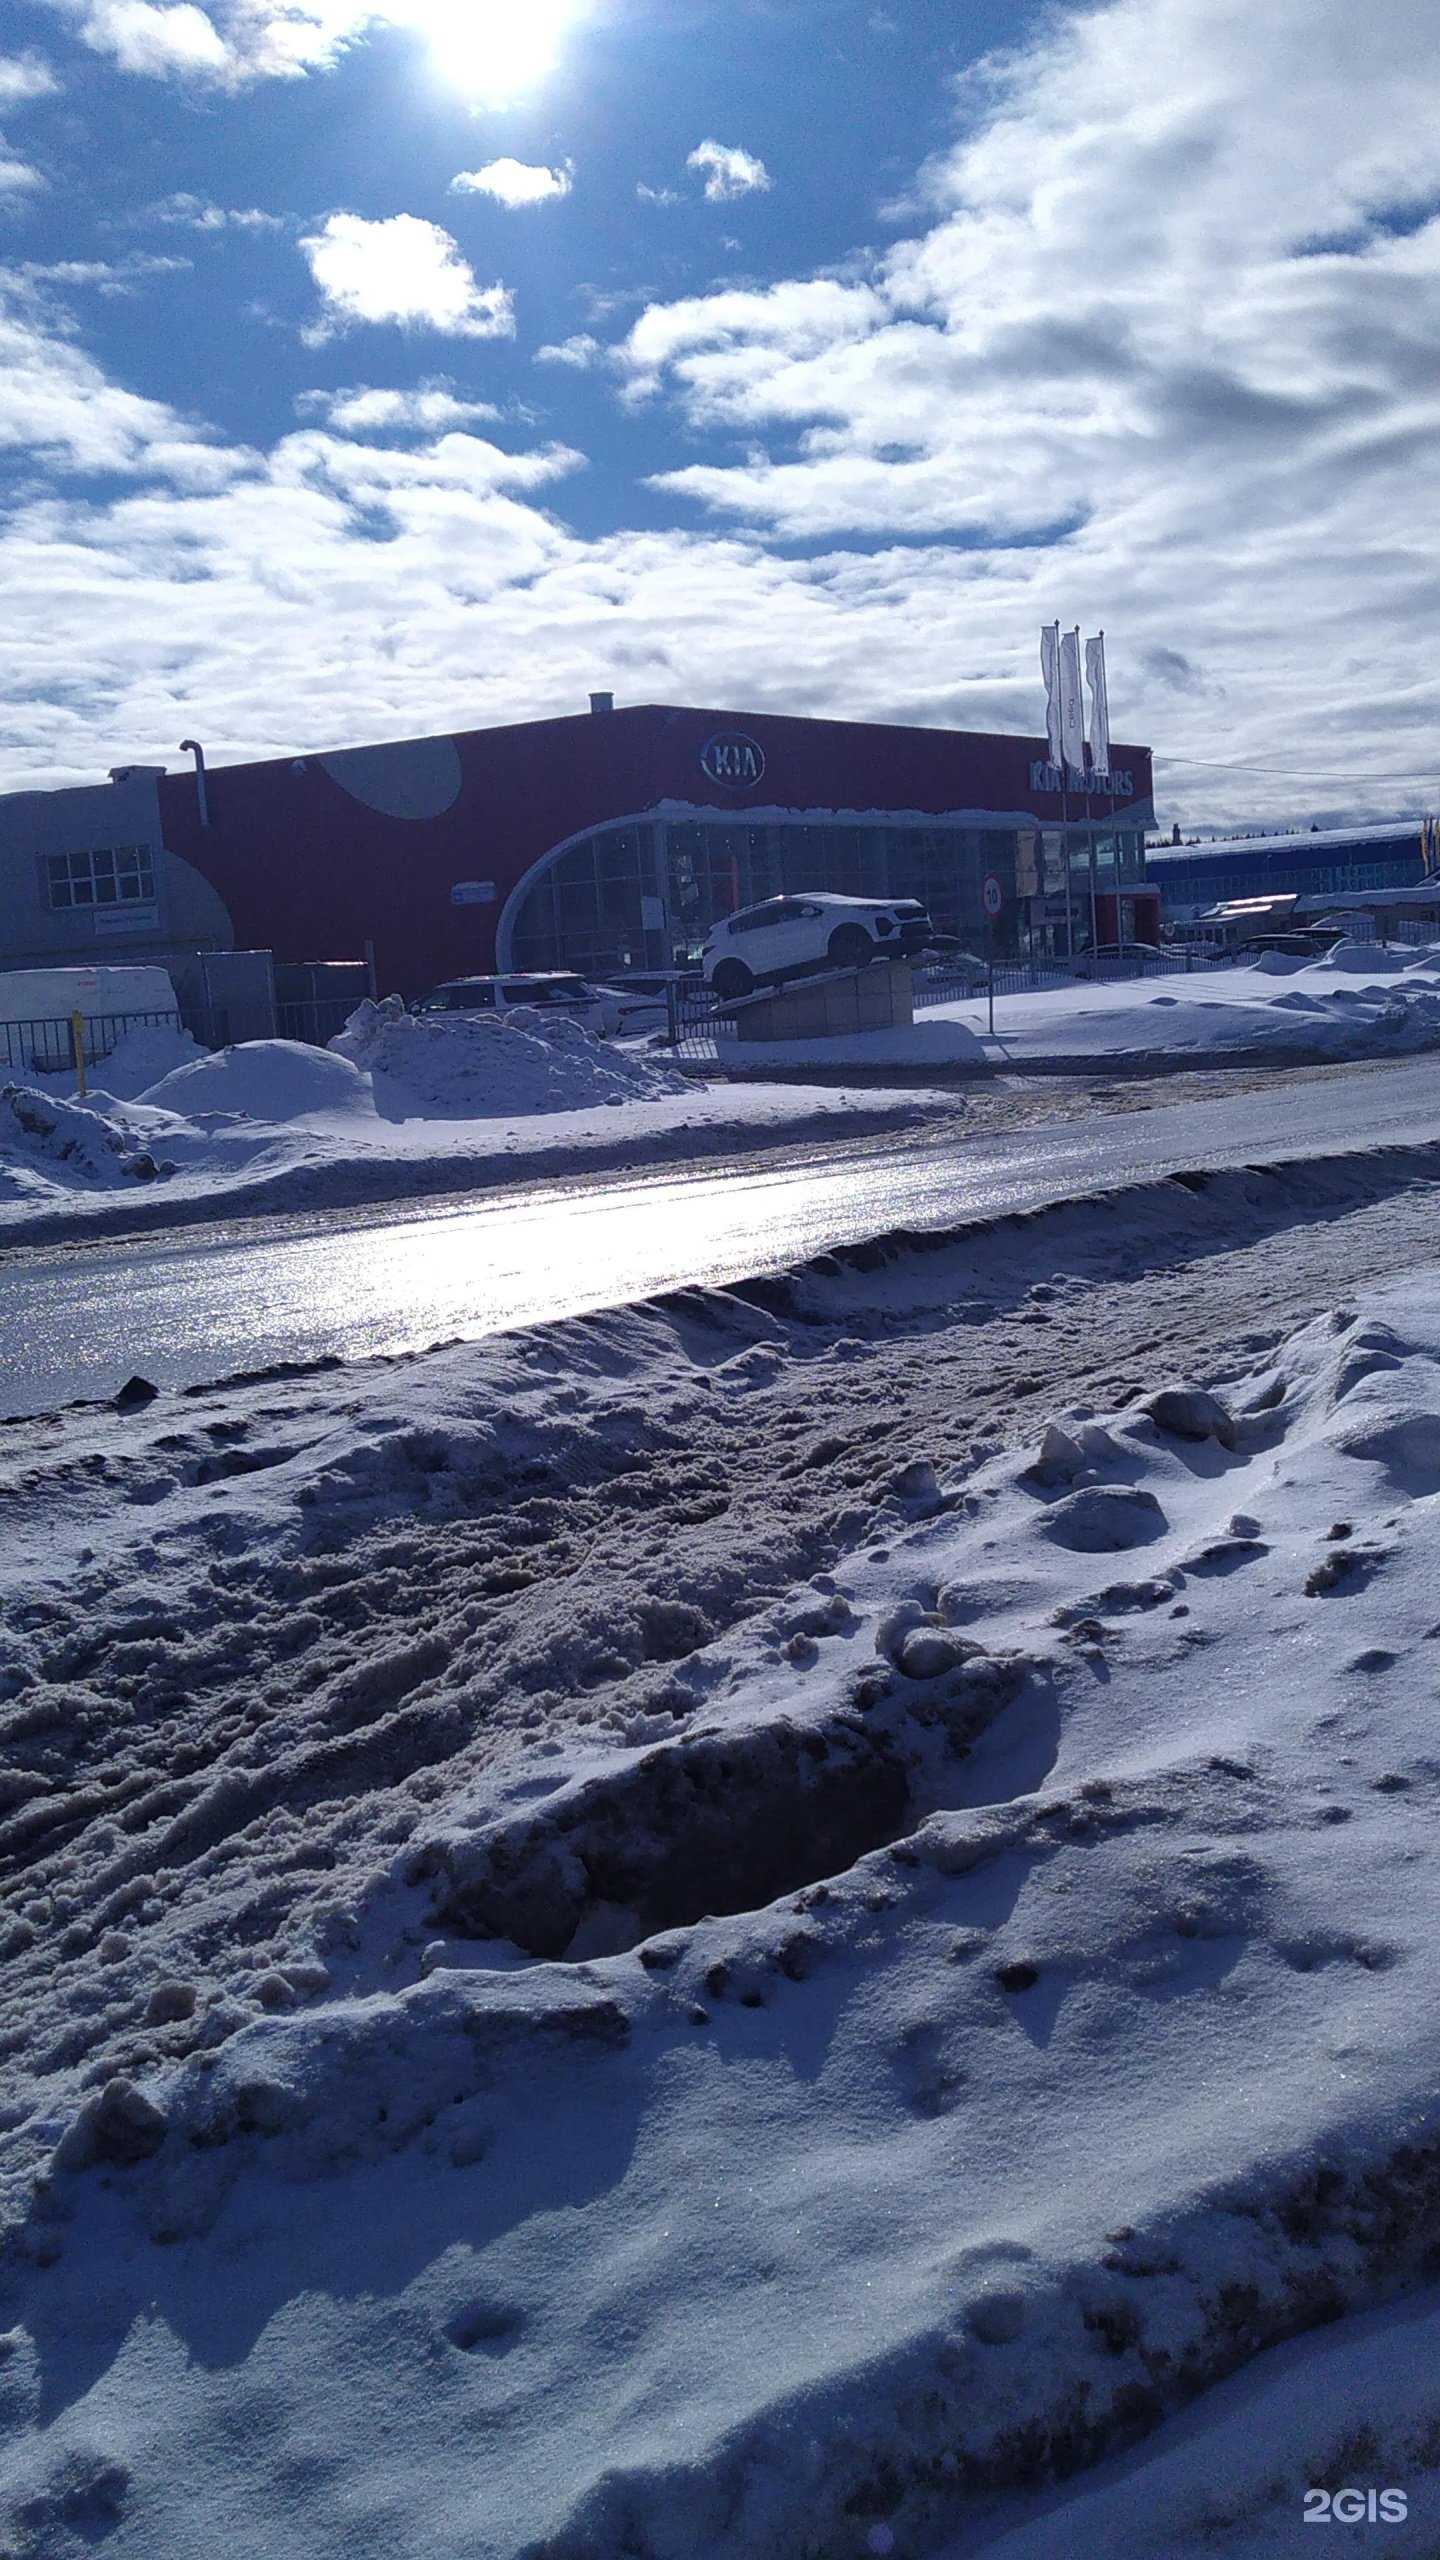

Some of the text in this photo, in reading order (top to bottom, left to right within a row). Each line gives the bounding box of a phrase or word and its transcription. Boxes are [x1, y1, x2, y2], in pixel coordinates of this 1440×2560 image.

[713, 746, 757, 776] KIA
[1030, 760, 1133, 796] KIA MOTORS
[987, 887, 998, 905] 10
